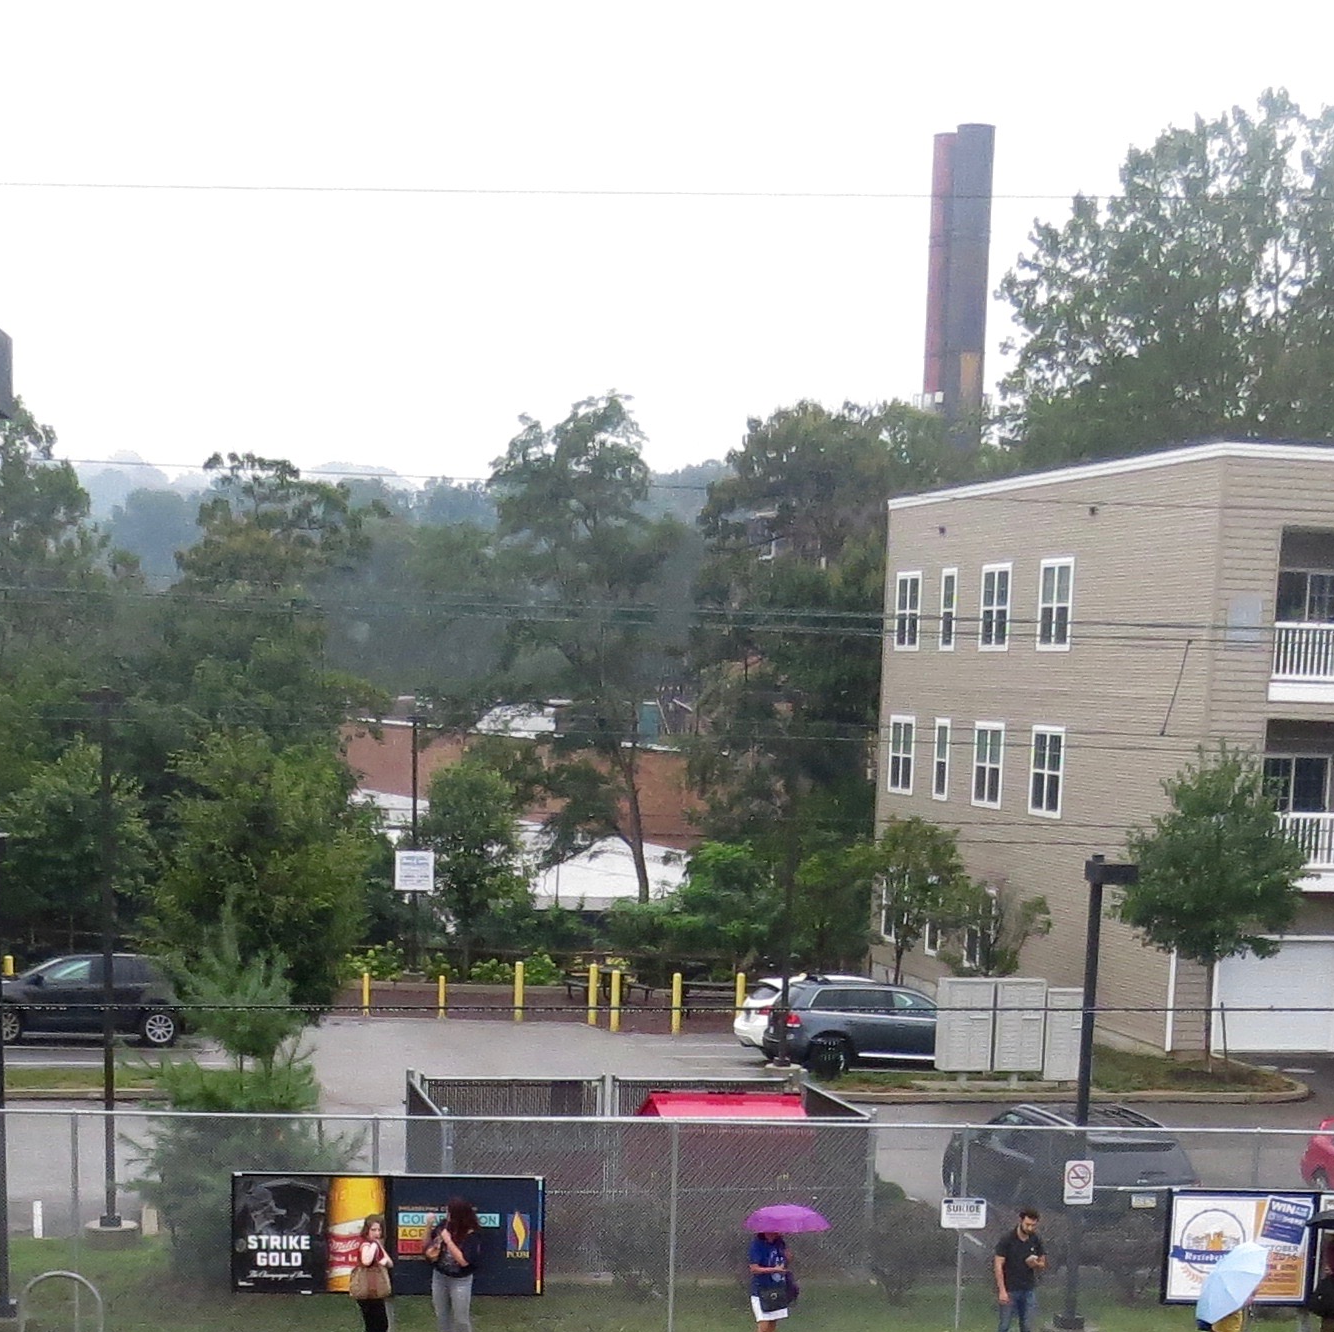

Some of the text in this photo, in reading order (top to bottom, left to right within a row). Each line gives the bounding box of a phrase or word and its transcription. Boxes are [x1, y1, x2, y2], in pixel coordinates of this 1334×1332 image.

[1271, 1201, 1296, 1214] WIN
[247, 1235, 311, 1250] STRIKE
[256, 1252, 302, 1267] GOLD
